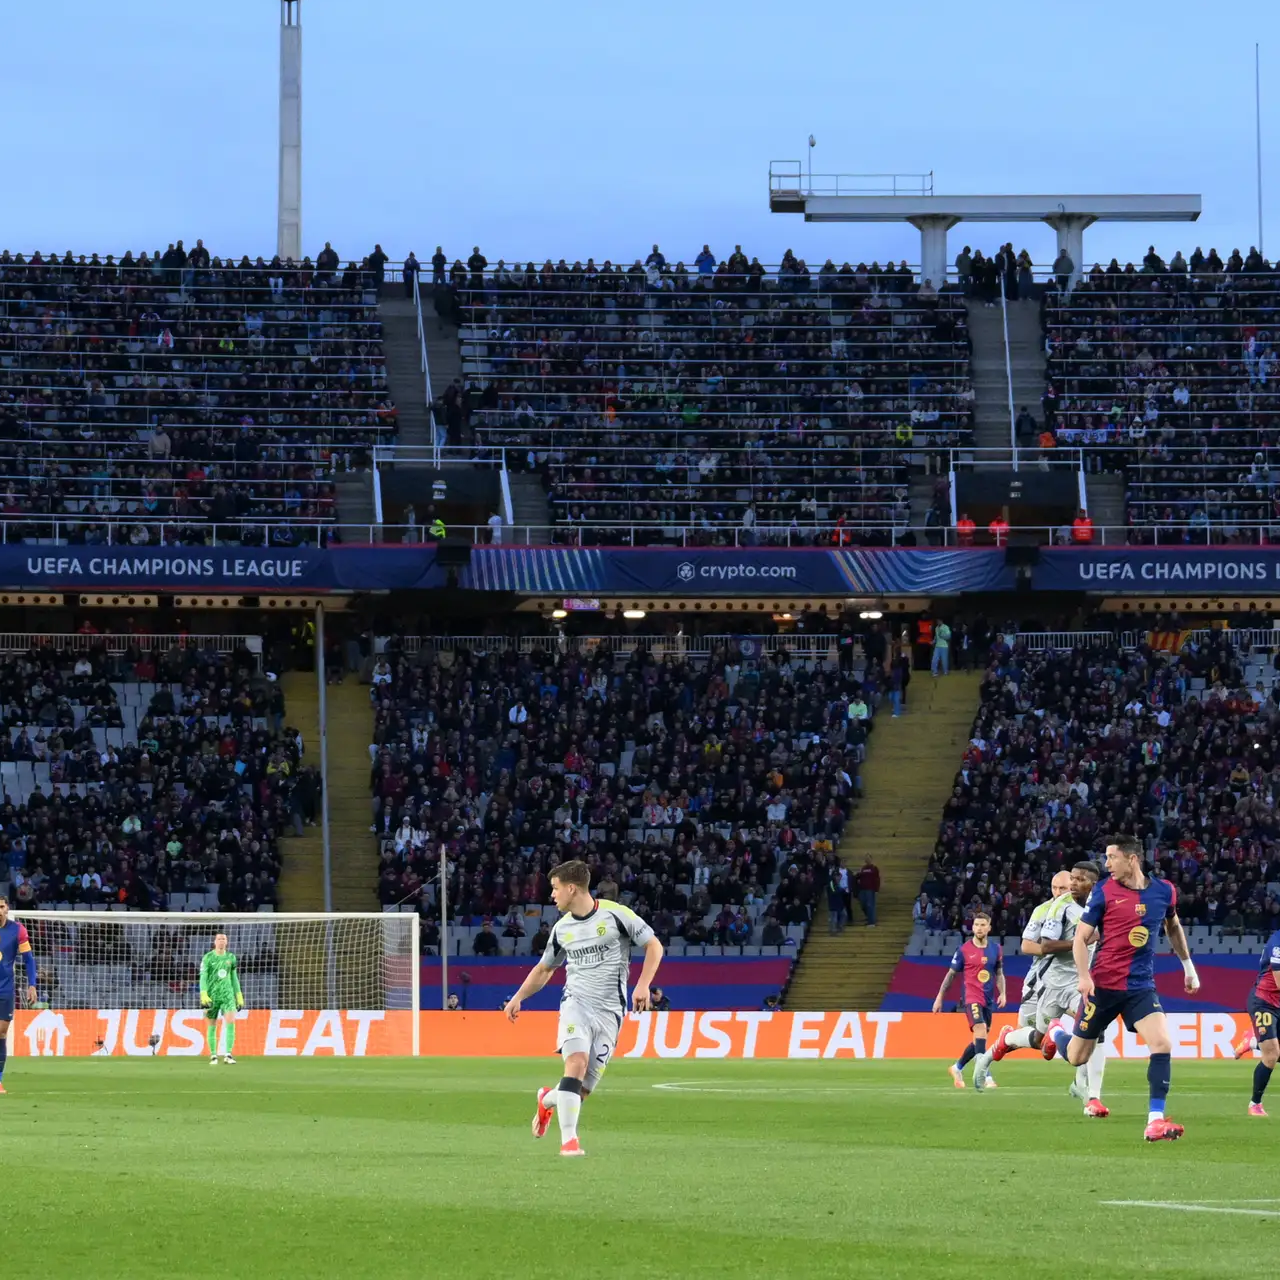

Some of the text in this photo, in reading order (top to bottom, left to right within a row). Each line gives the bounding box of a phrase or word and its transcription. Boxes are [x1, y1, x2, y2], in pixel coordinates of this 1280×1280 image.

[27, 558, 303, 577] UEFA CHAMPIONS LEAGUE
[700, 563, 797, 579] crypto.com
[1079, 562, 1135, 579] UEFA
[1141, 562, 1267, 580] CHAMPIONS
[567, 943, 610, 960] Emirates
[971, 1003, 979, 1014] 5
[1084, 1001, 1097, 1020] 9
[1254, 1011, 1273, 1027] 20
[263, 1010, 385, 1056] EAT
[624, 1011, 903, 1059] JUST EAT
[596, 1043, 610, 1065] 2
